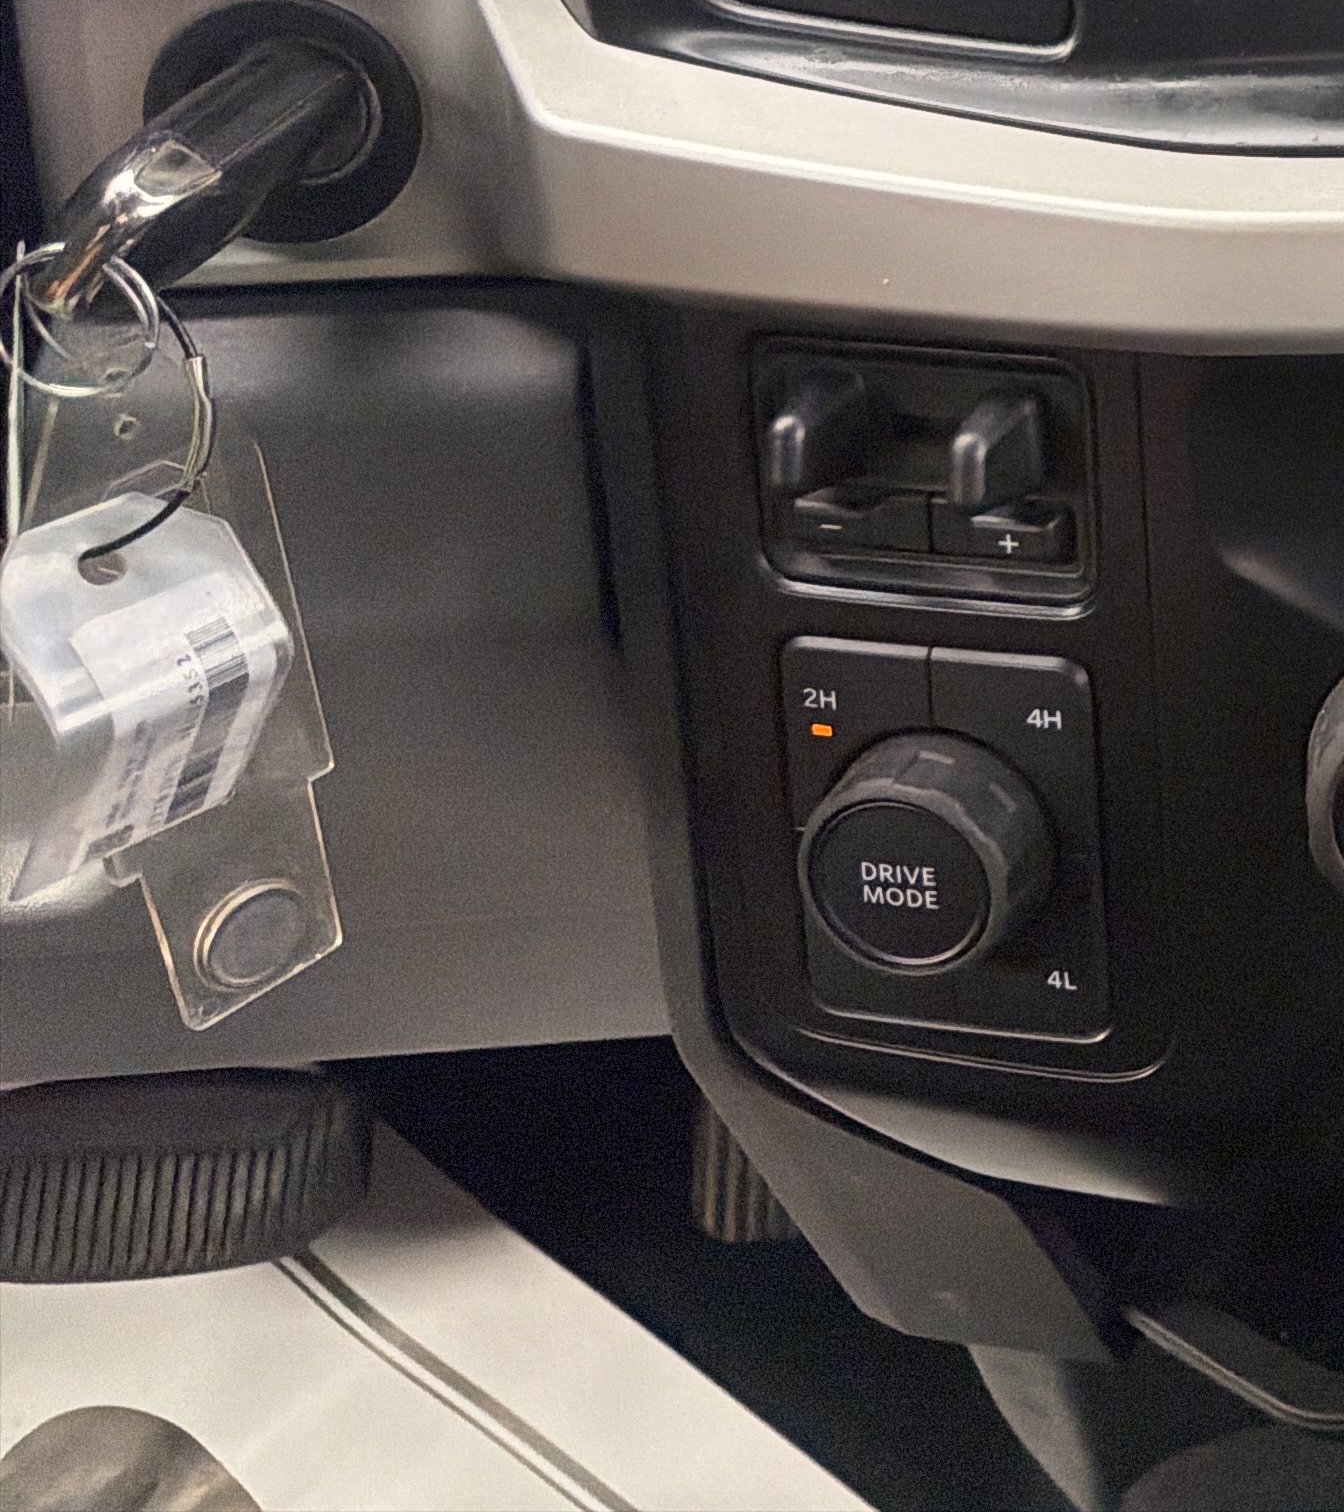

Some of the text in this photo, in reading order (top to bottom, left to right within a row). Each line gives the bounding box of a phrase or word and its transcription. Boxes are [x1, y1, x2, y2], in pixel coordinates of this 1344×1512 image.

[803, 687, 837, 710] 2H
[1026, 708, 1062, 730] 4H
[860, 862, 937, 887] DRIVE
[862, 885, 939, 910] MODE
[1047, 970, 1077, 991] 4L
